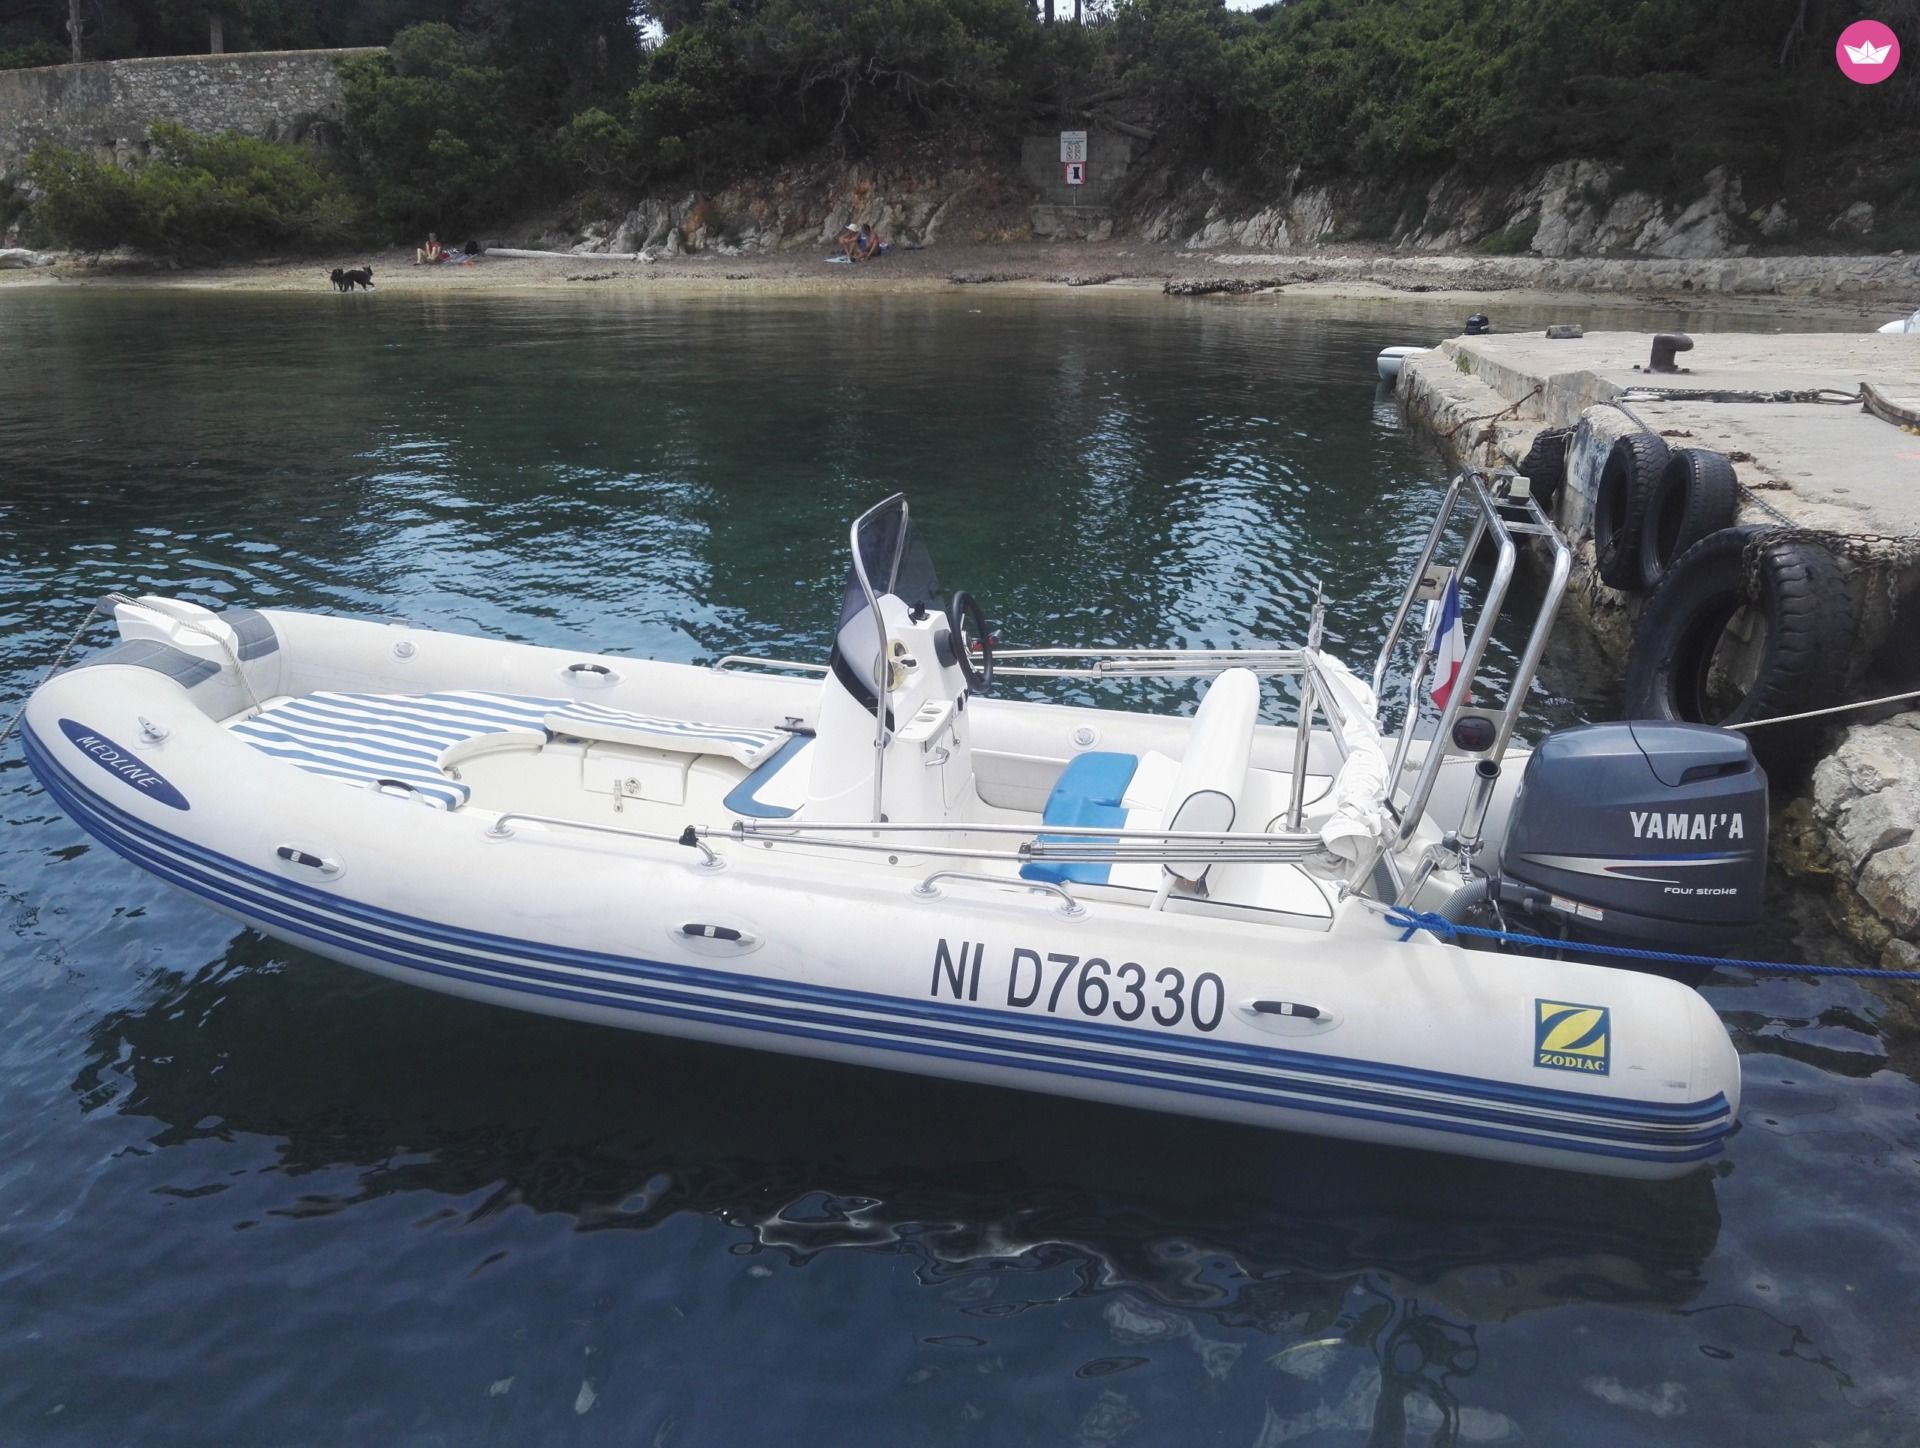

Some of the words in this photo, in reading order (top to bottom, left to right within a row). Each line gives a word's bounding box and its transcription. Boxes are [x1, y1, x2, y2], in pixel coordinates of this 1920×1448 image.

[76, 736, 163, 788] MEDLINE
[930, 938, 984, 1001] NI
[1007, 947, 1225, 1032] D76330
[1539, 1053, 1605, 1071] ZODIAC
